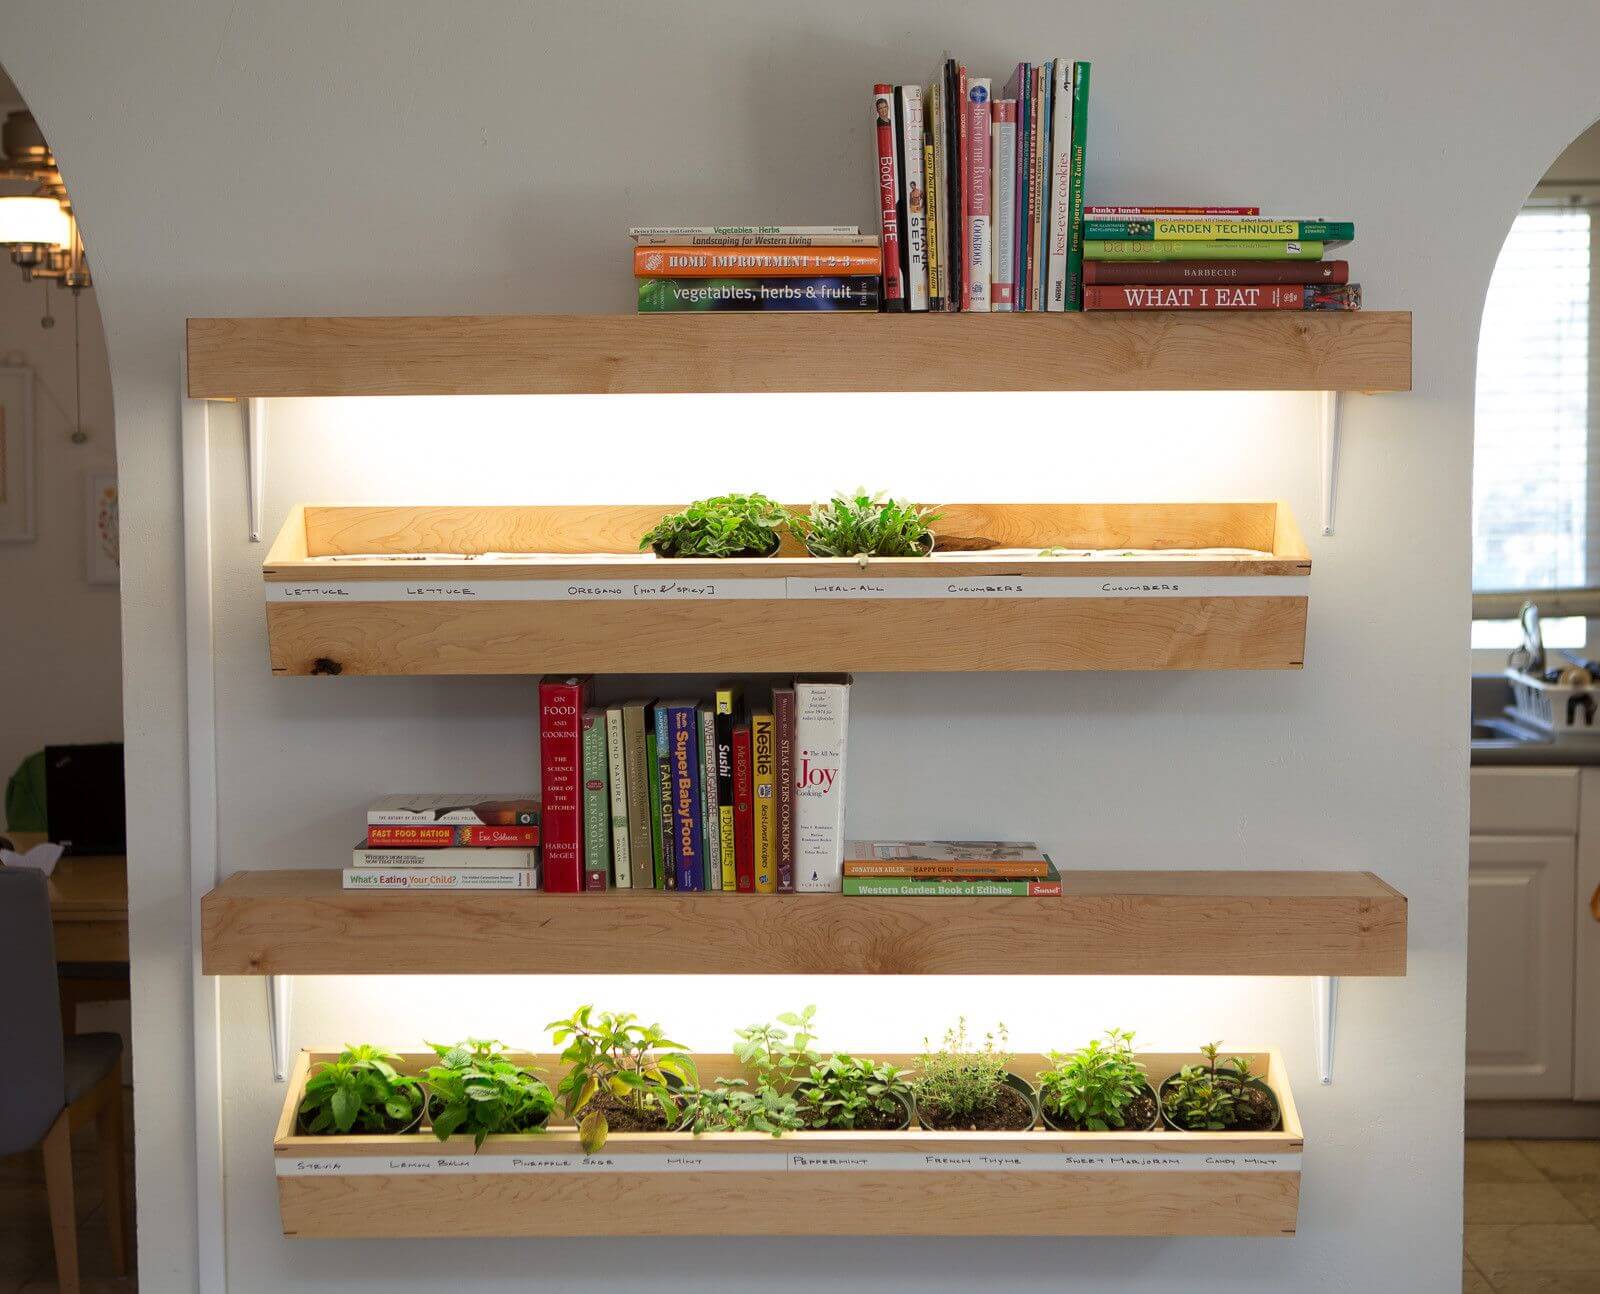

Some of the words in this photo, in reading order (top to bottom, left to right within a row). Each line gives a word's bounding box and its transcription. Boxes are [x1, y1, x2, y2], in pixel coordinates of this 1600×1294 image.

[1073, 146, 1083, 177] Zucchini
[880, 156, 893, 190] Body
[1056, 152, 1069, 198] cookies
[1073, 179, 1081, 187] to
[1072, 190, 1082, 230] Asparagus
[713, 226, 753, 235] Vegetables
[758, 226, 780, 234] Herbs
[883, 209, 898, 243] LIFE
[1160, 224, 1212, 234] GARDEN
[1215, 224, 1293, 235] TECHNIQUES
[692, 236, 740, 247] Landscaping
[741, 236, 752, 247] for
[755, 236, 786, 246] Western
[788, 236, 812, 247] Living
[911, 217, 921, 264] SEPE
[972, 218, 985, 266] COOKBOOK
[1071, 232, 1079, 252] From
[669, 255, 706, 267] HOME
[712, 255, 809, 267] IMPROVEMENT
[815, 255, 851, 267] 1-2-3
[1184, 269, 1237, 277] BARBECUE
[673, 286, 756, 302] vegetables,
[760, 285, 801, 300] herbs
[806, 286, 816, 299] &
[821, 285, 851, 300] fruit
[1124, 288, 1193, 307] WHAT
[1199, 289, 1208, 307] I
[1215, 289, 1260, 307] EAT
[284, 587, 348, 596] LETTUCE
[406, 586, 475, 596] LETTUCE
[568, 586, 622, 595] OREGANO
[948, 584, 1023, 593] CUCUMBERS
[1101, 583, 1179, 592] CUCUMBERS
[544, 706, 576, 715] FOOD
[543, 731, 578, 739] COOKING
[611, 719, 619, 759] SECOND
[675, 731, 689, 777] Super
[781, 739, 790, 766] STEAK
[718, 744, 731, 777] Sushi
[660, 764, 672, 801] FARM
[678, 778, 692, 816] Baby
[662, 804, 673, 835] CITY
[761, 804, 769, 842] Best-Loved
[372, 829, 391, 838] FAST
[395, 829, 417, 838] FOOD
[420, 829, 450, 838] NATION
[478, 831, 490, 842] Eric
[590, 796, 598, 866] KINGSOLVER
[681, 818, 695, 856] Food
[782, 804, 791, 861] COOKBOOK
[545, 842, 578, 850] HAROLD
[722, 817, 733, 866] DUMMIES
[761, 842, 770, 868] Recipes
[350, 875, 377, 884] What's
[379, 875, 407, 886] Eating
[409, 876, 427, 884] Your
[429, 875, 457, 884] Child?
[858, 885, 899, 894] Western
[901, 885, 936, 894] Garden
[938, 885, 962, 894] Book
[964, 885, 974, 894] of
[976, 885, 1012, 894] Edibles
[1033, 885, 1060, 894] Sunset
[389, 1158, 430, 1168] LEMON
[582, 1157, 615, 1166] SAGE
[793, 1156, 868, 1166] PEPPERMINT
[925, 1156, 972, 1164] FRENCH
[979, 1156, 1021, 1165] THYME
[1065, 1157, 1104, 1165] SWEET
[1110, 1157, 1182, 1166] MARJORAM
[1205, 1156, 1236, 1166] CANDY
[1244, 1157, 1278, 1165] MINT
